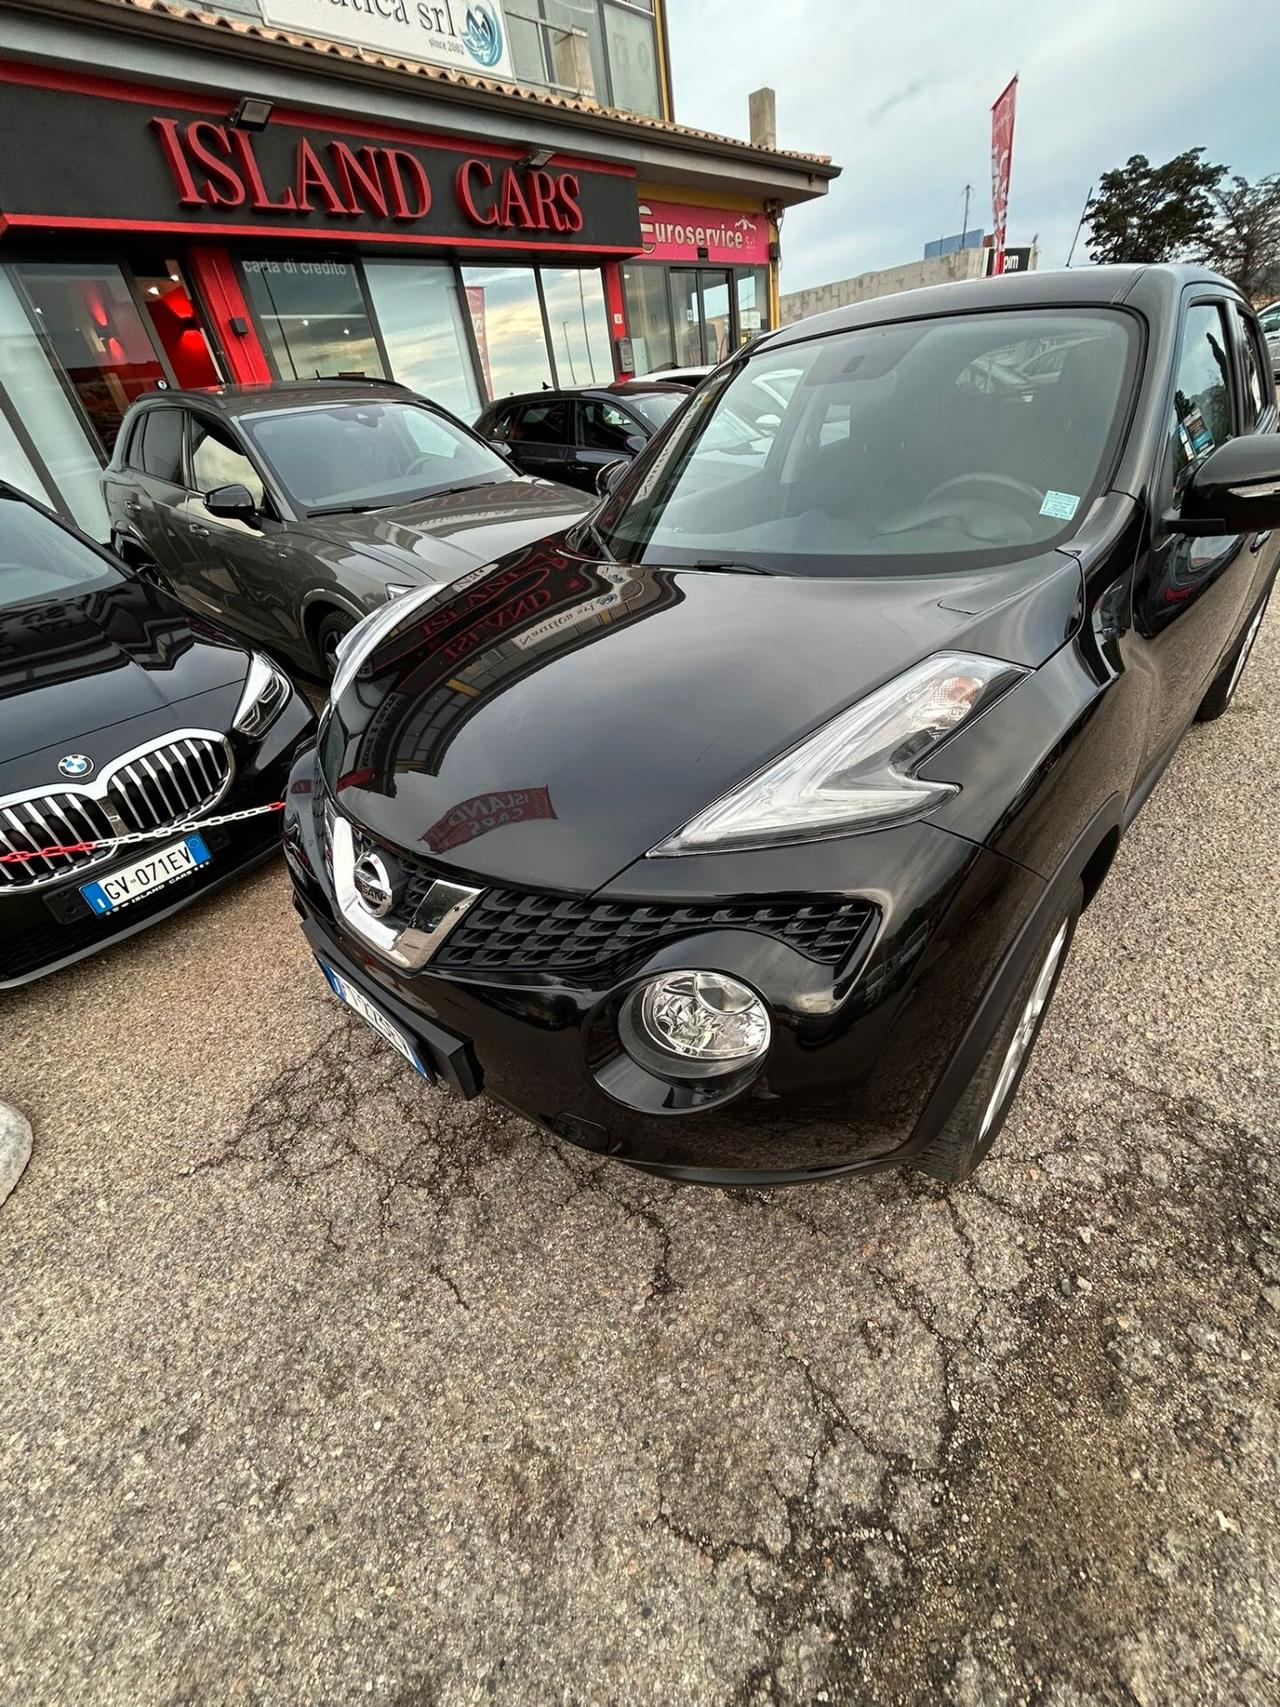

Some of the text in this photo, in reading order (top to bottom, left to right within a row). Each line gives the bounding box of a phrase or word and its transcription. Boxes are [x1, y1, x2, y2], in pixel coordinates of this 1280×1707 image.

[416, 0, 457, 37] srl
[151, 116, 583, 233] ISLAND CARS
[242, 259, 347, 275] carta di credito
[131, 869, 193, 904] ISLAND CARS
